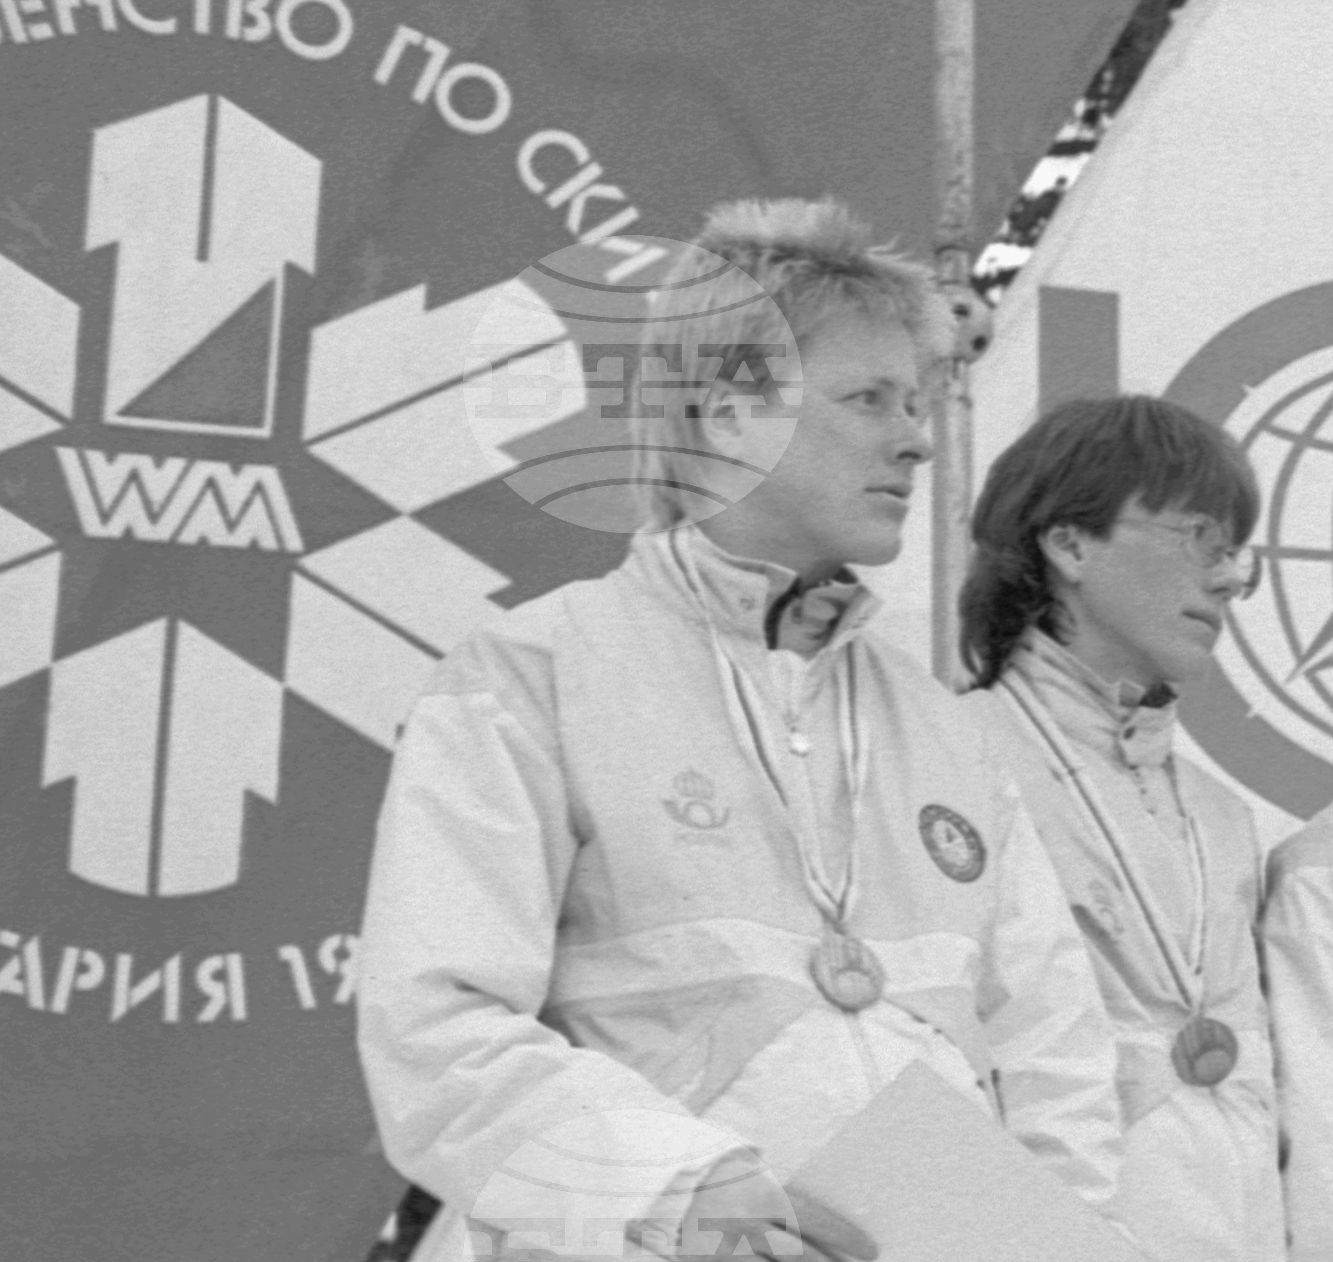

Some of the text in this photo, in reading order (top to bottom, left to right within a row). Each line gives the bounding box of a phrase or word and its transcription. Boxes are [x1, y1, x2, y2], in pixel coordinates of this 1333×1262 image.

[373, 24, 511, 134] ПО
[516, 129, 669, 283] СКИ
[54, 446, 304, 553] WM
[0, 929, 248, 1023] АРИЯ
